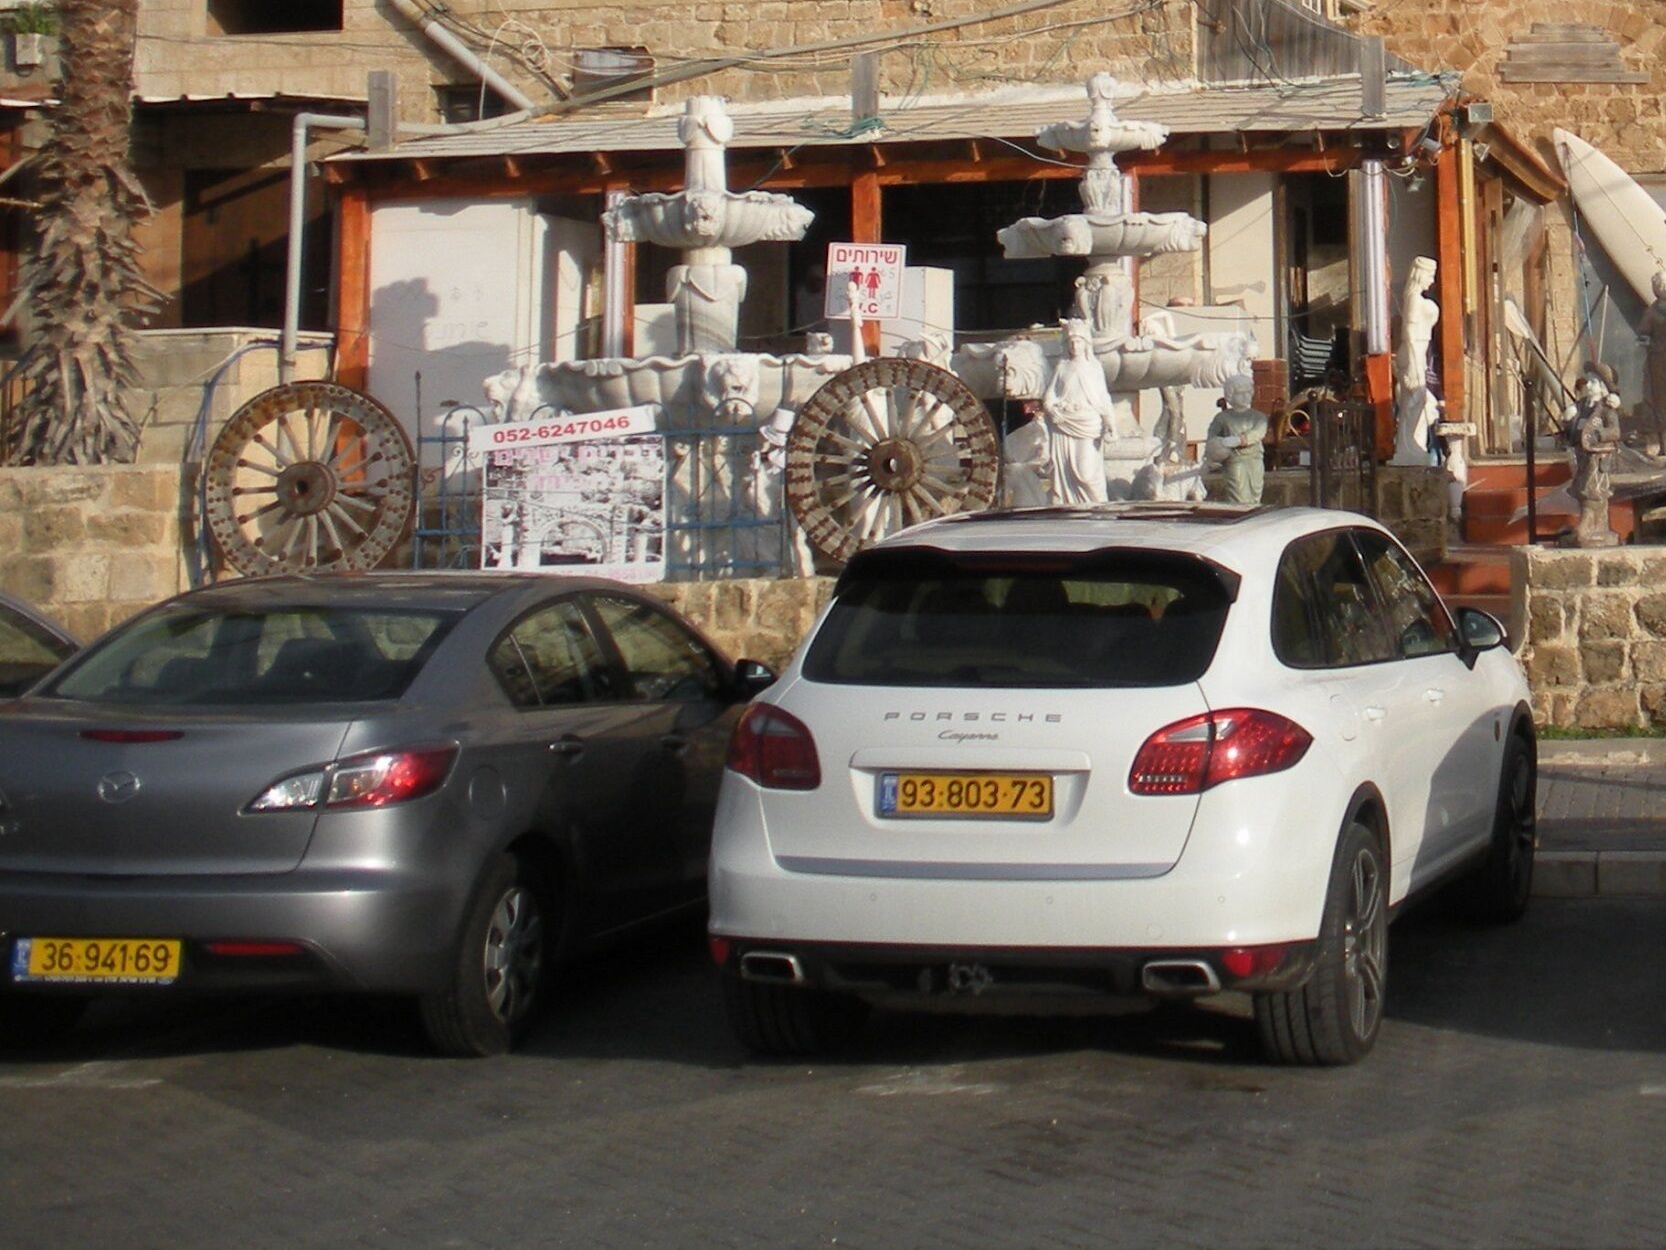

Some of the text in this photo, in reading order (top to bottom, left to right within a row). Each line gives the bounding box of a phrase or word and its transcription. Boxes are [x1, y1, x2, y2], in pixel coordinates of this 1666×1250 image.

[836, 248, 898, 264] שירותים
[493, 415, 631, 444] 052-6247046
[884, 711, 1064, 723] PORSCHE
[937, 729, 999, 744] Cayenne
